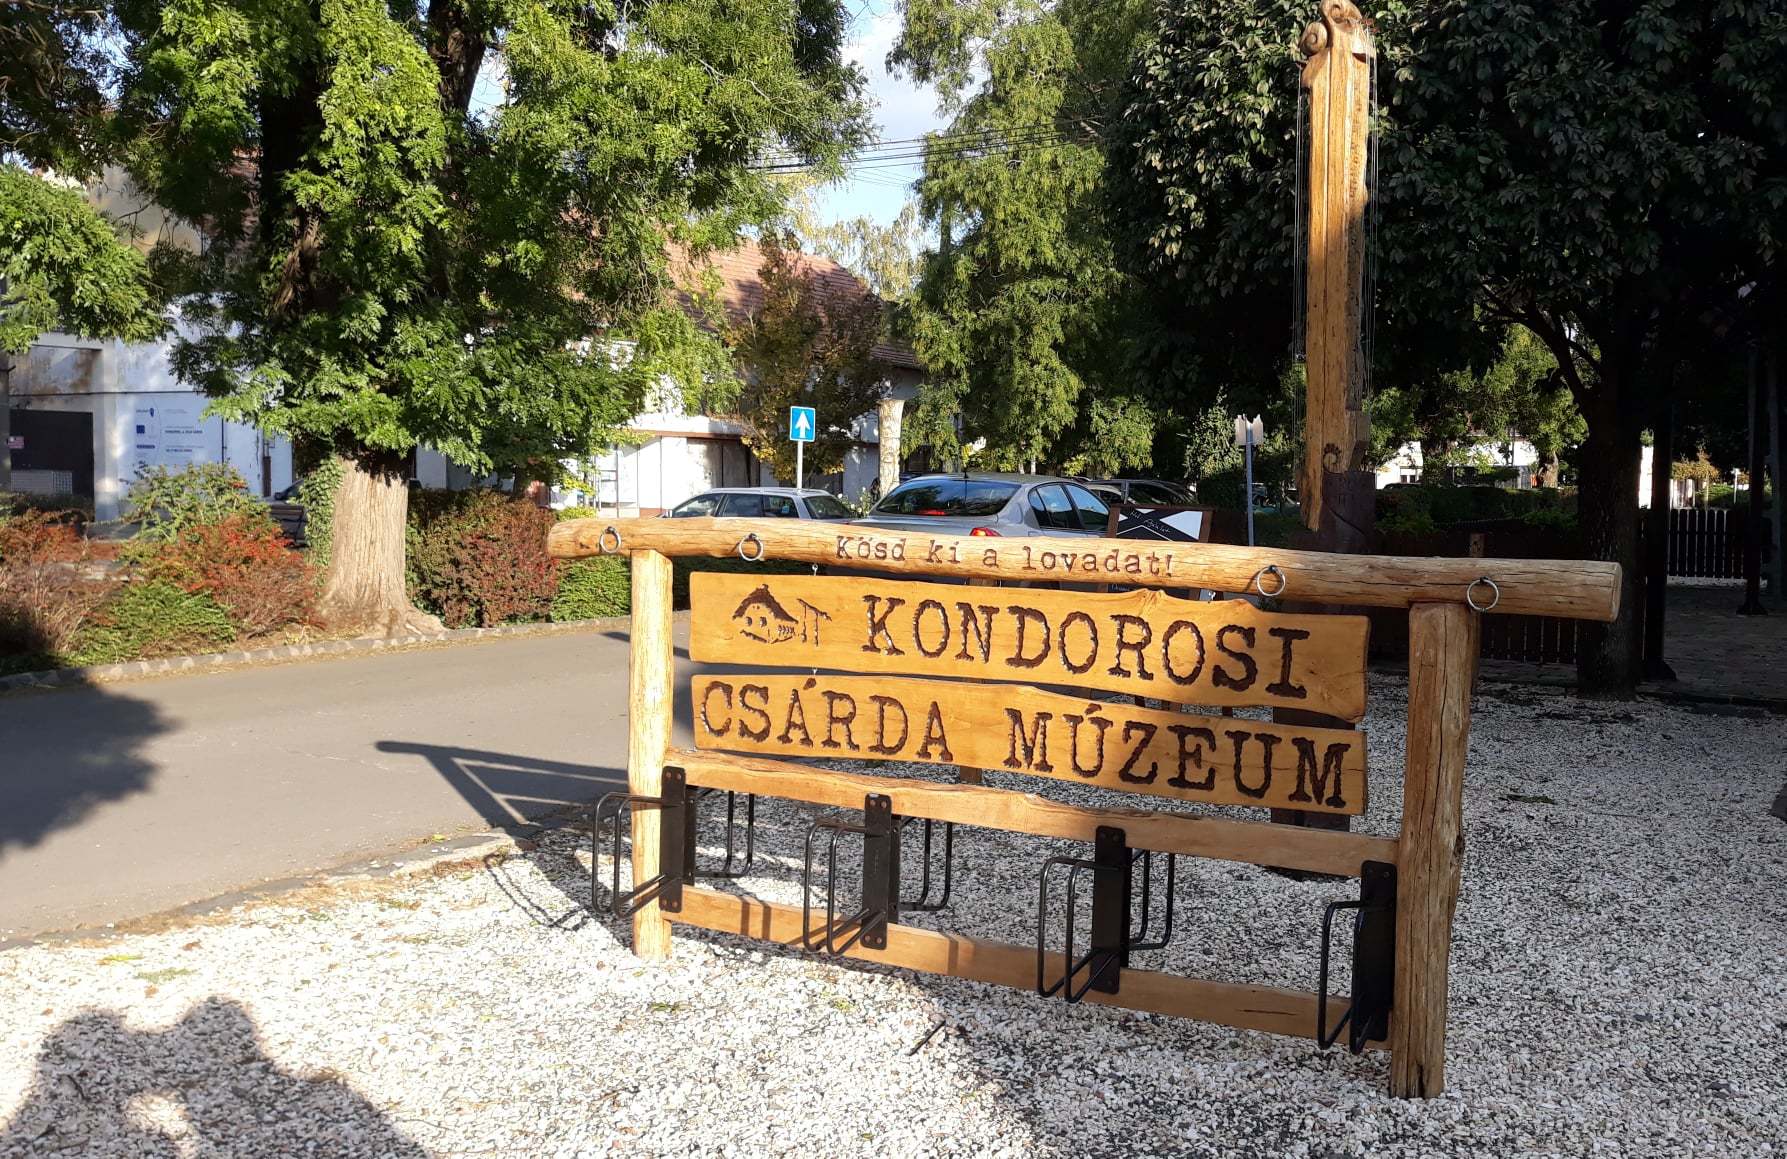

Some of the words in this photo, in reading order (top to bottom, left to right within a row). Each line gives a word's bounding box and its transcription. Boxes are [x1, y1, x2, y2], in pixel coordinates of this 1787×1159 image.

[836, 535, 907, 561] Kösd
[925, 539, 961, 564] ki
[982, 548, 999, 568] a
[1022, 545, 1173, 577] lovadat!
[860, 594, 1310, 699] KONDOROSI
[701, 677, 954, 762] CSÁRDA
[1002, 703, 1351, 808] MÚZEUM
